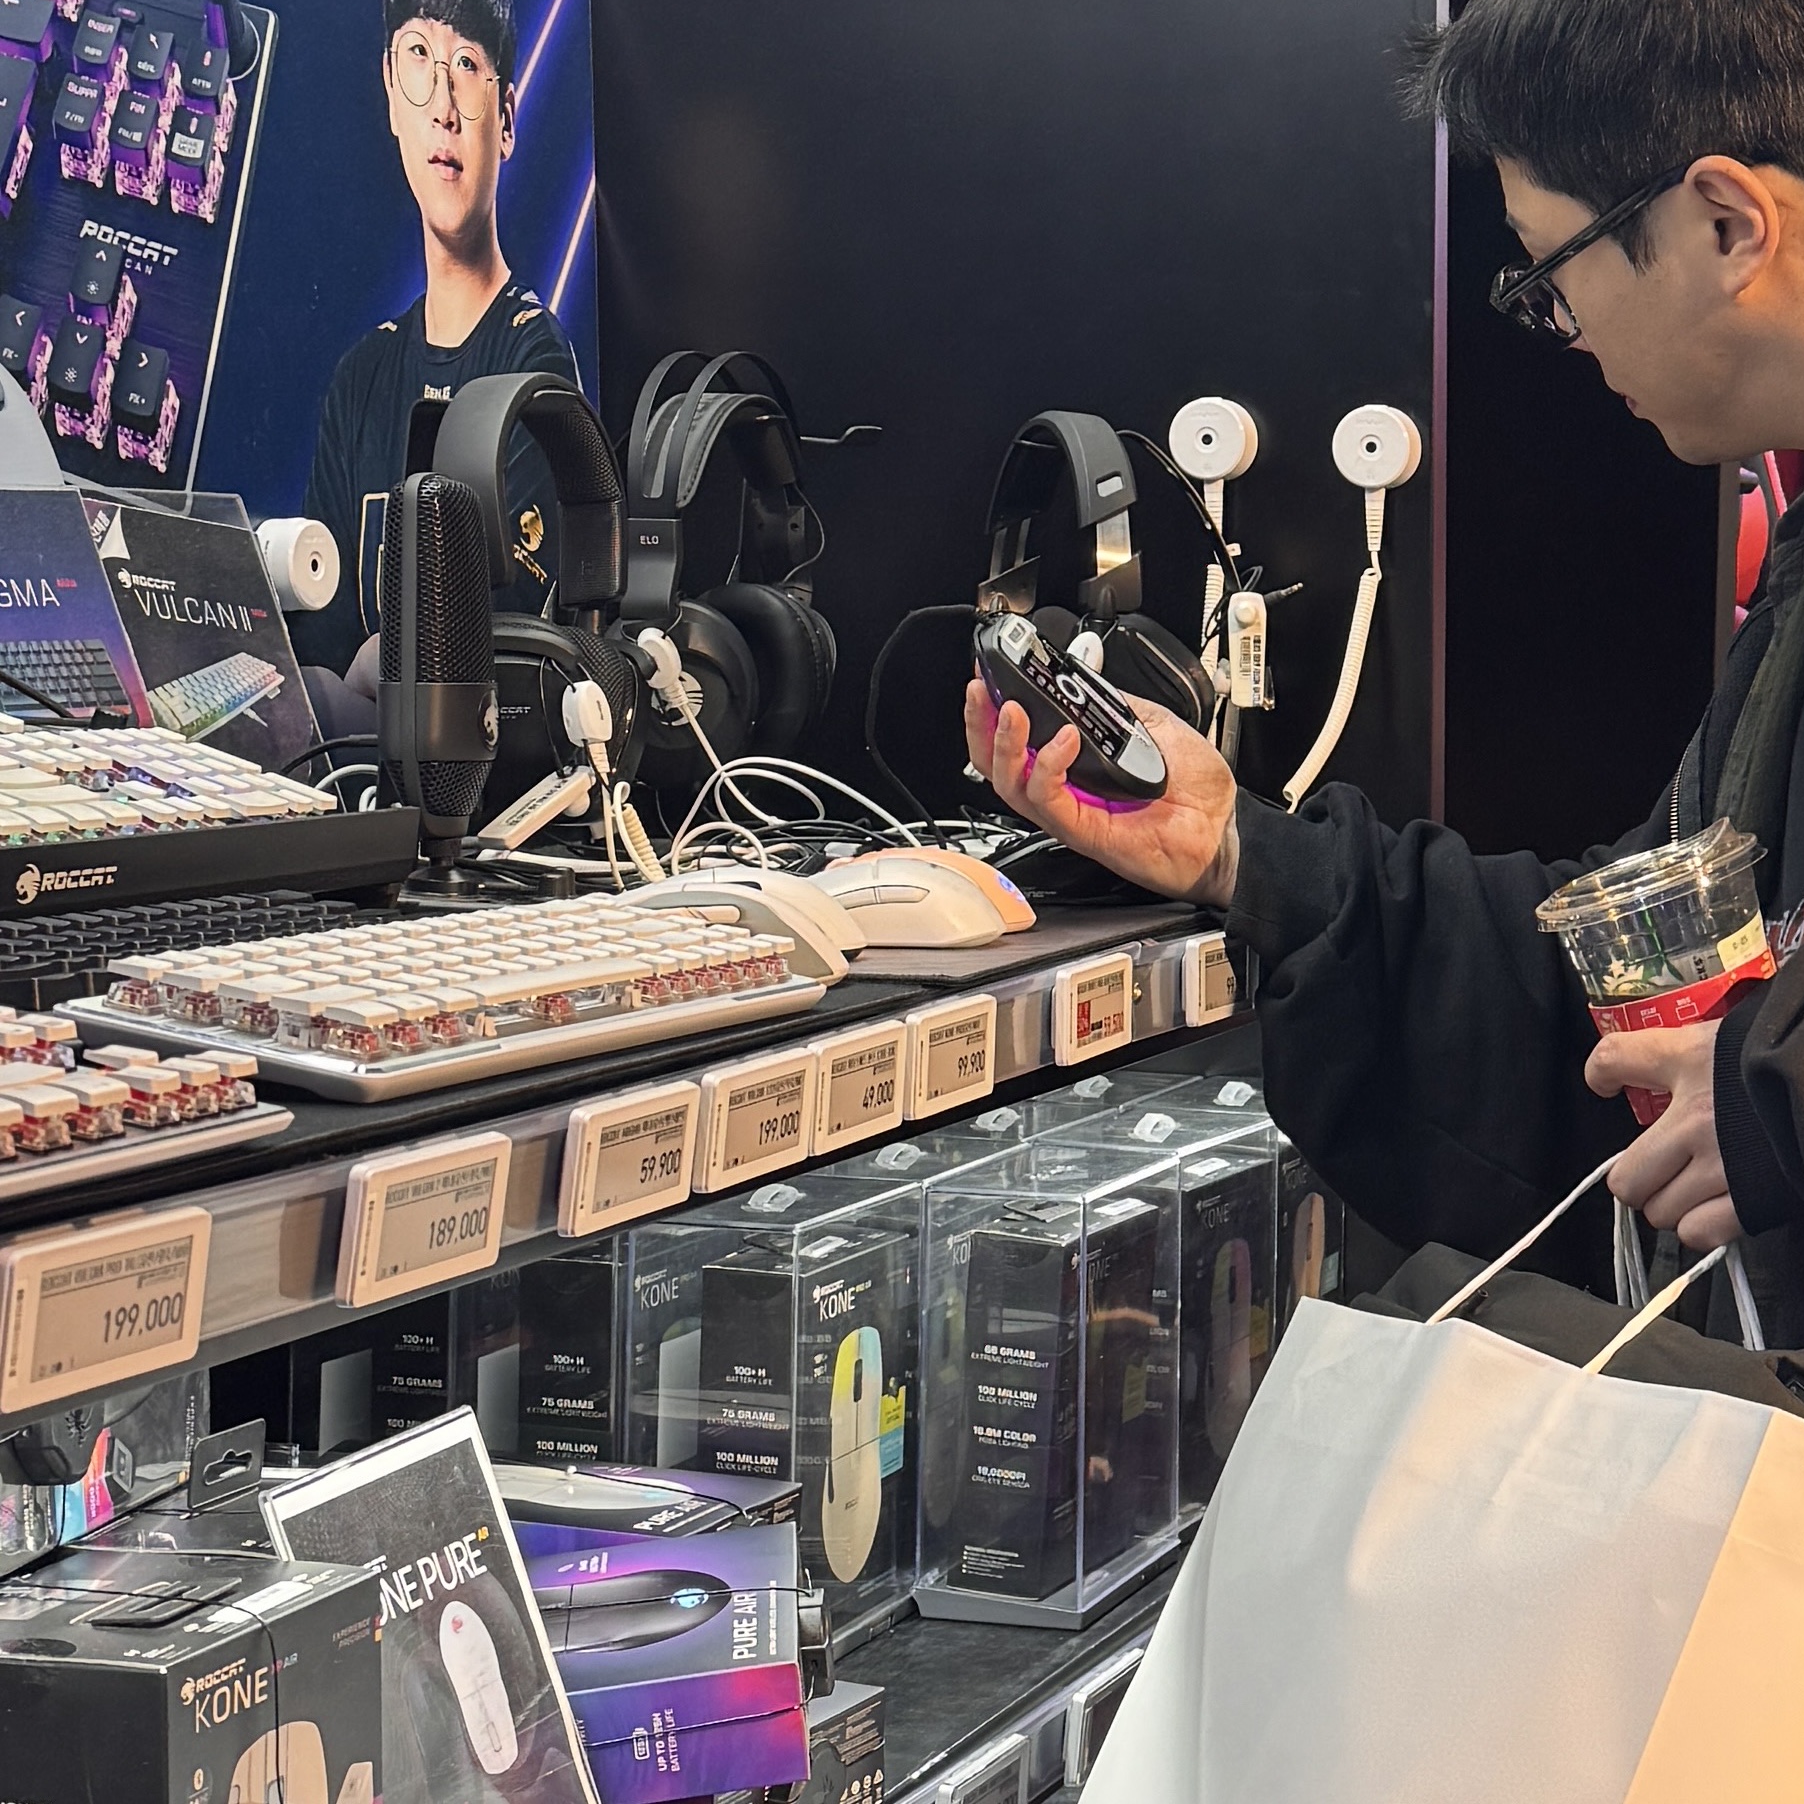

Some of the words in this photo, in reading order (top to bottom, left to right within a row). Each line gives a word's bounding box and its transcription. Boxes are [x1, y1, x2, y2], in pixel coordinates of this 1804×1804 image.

[79, 219, 179, 266] ROCCAT
[134, 589, 241, 631] VULCAN
[40, 864, 119, 892] ROCCAT
[641, 1277, 680, 1311] KONE
[820, 1287, 856, 1323] KONE
[556, 1441, 598, 1454] MILLION
[736, 1453, 779, 1466] MILLION
[416, 1532, 489, 1599] PURE
[733, 1617, 758, 1660] PURE
[194, 1666, 269, 1734] KONE
[664, 1707, 676, 1729] LIFE
[667, 1730, 681, 1773] BATTERY
